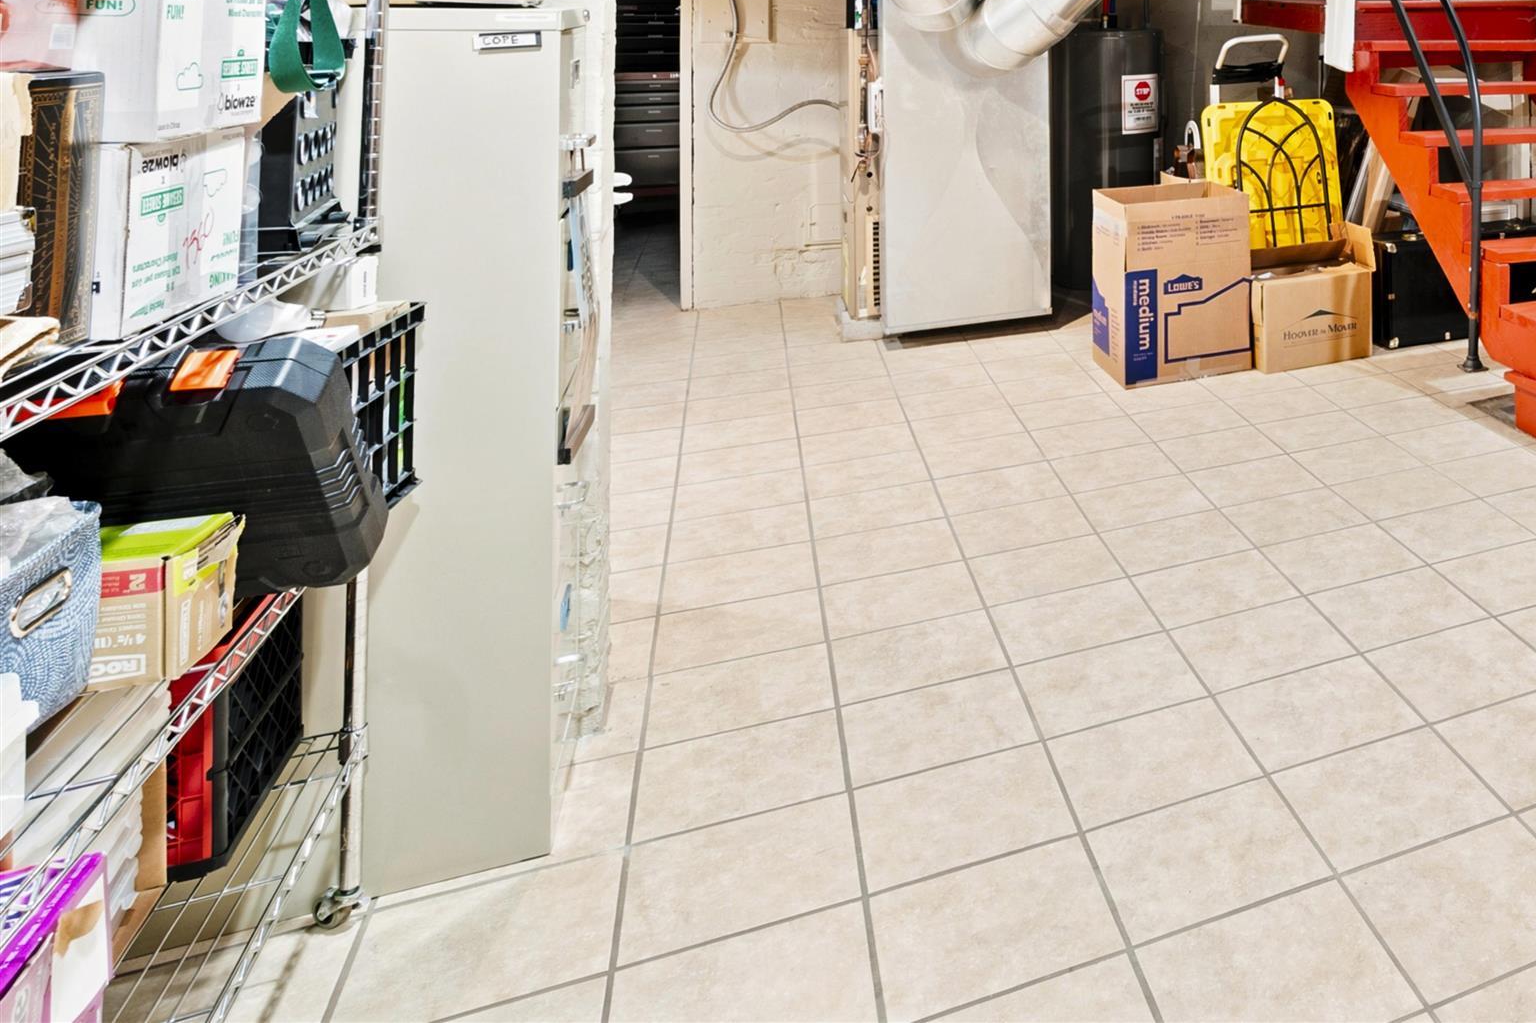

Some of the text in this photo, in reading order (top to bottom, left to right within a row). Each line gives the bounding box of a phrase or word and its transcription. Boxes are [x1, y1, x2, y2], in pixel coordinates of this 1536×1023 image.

[86, 0, 123, 11] FUN!
[482, 35, 519, 46] COPE
[1136, 88, 1151, 96] STOP
[224, 94, 256, 111] blowze
[141, 153, 179, 173] blowze
[1168, 280, 1200, 293] LOWE'S
[1139, 279, 1154, 351] medium
